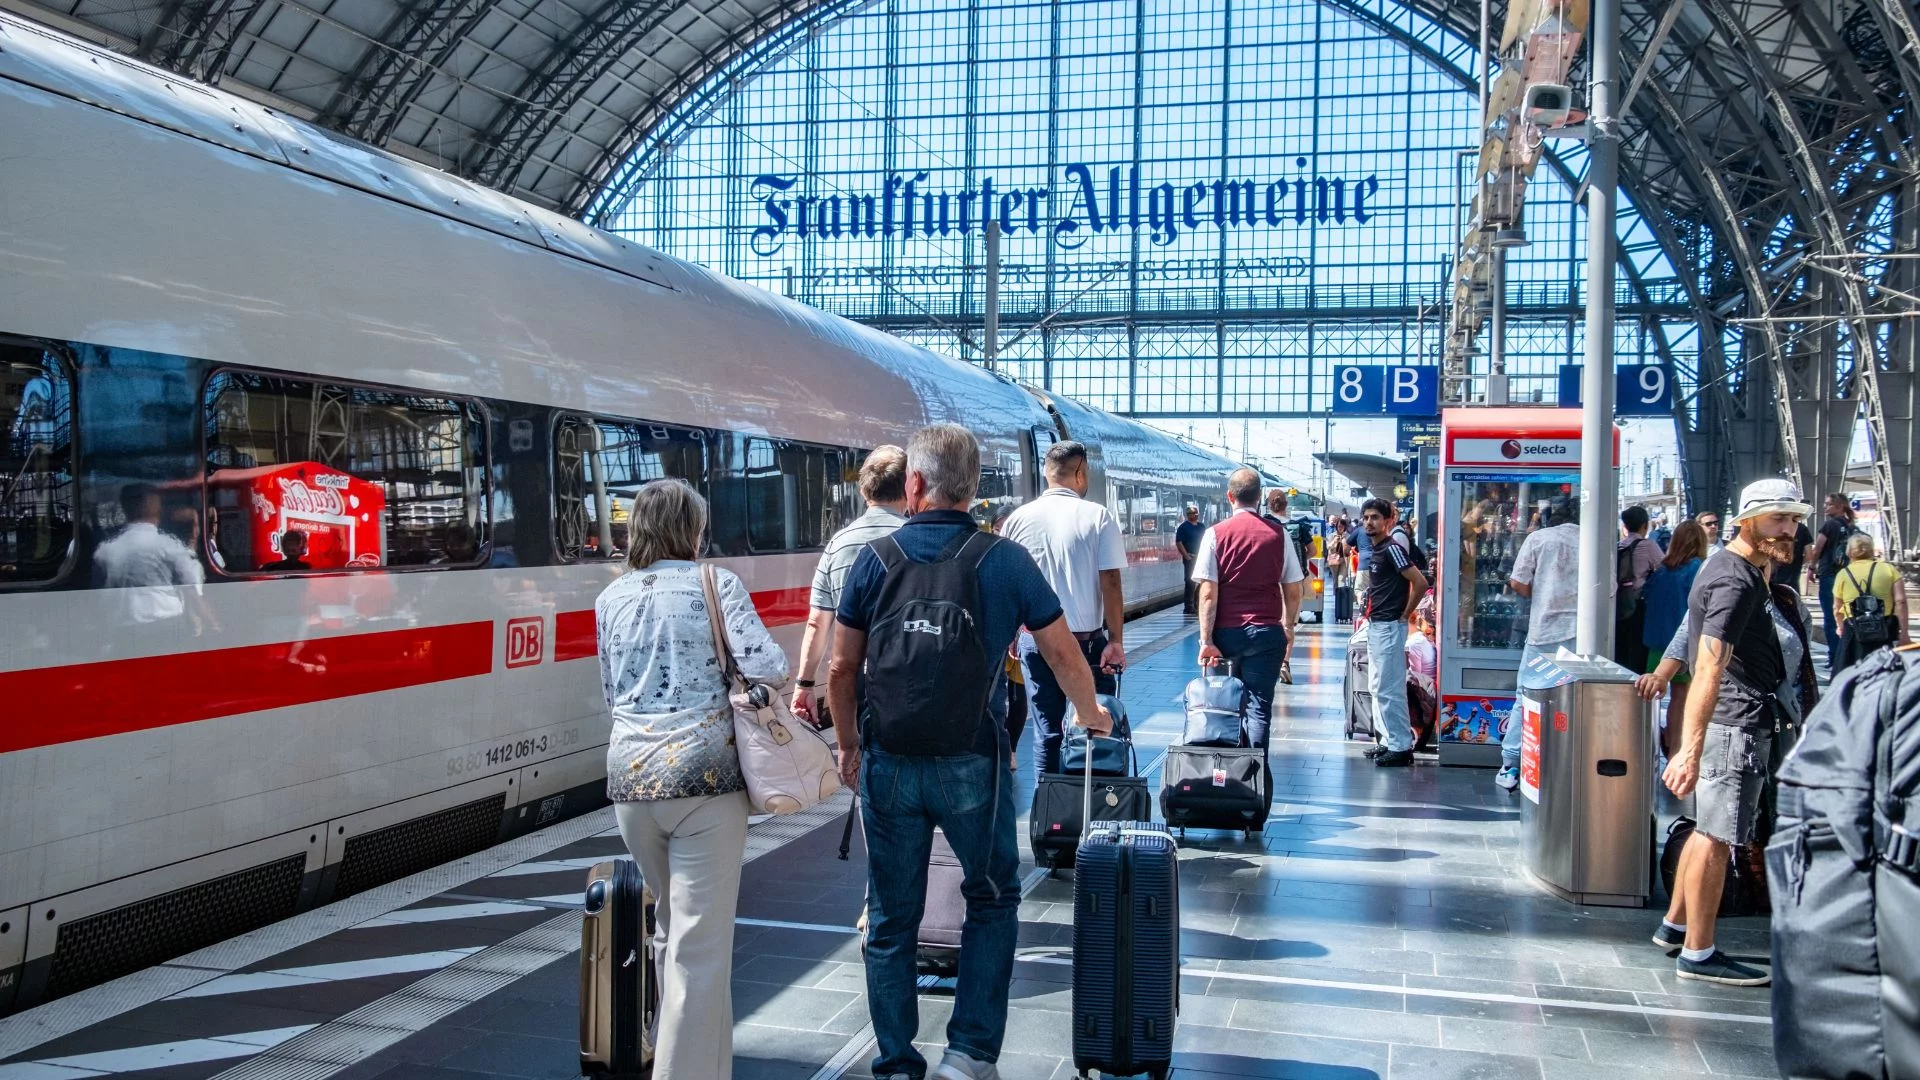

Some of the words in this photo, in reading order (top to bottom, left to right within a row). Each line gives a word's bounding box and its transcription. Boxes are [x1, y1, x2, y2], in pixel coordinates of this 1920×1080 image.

[750, 170, 1050, 257] Frankfurter
[1054, 156, 1379, 249] Allgemeine
[1339, 367, 1363, 403] 8
[1393, 367, 1420, 403] B
[1639, 366, 1666, 404] 9
[1523, 443, 1567, 456] selecta
[510, 624, 540, 661] DB
[485, 744, 513, 766] 1412
[515, 735, 548, 759] 061-3
